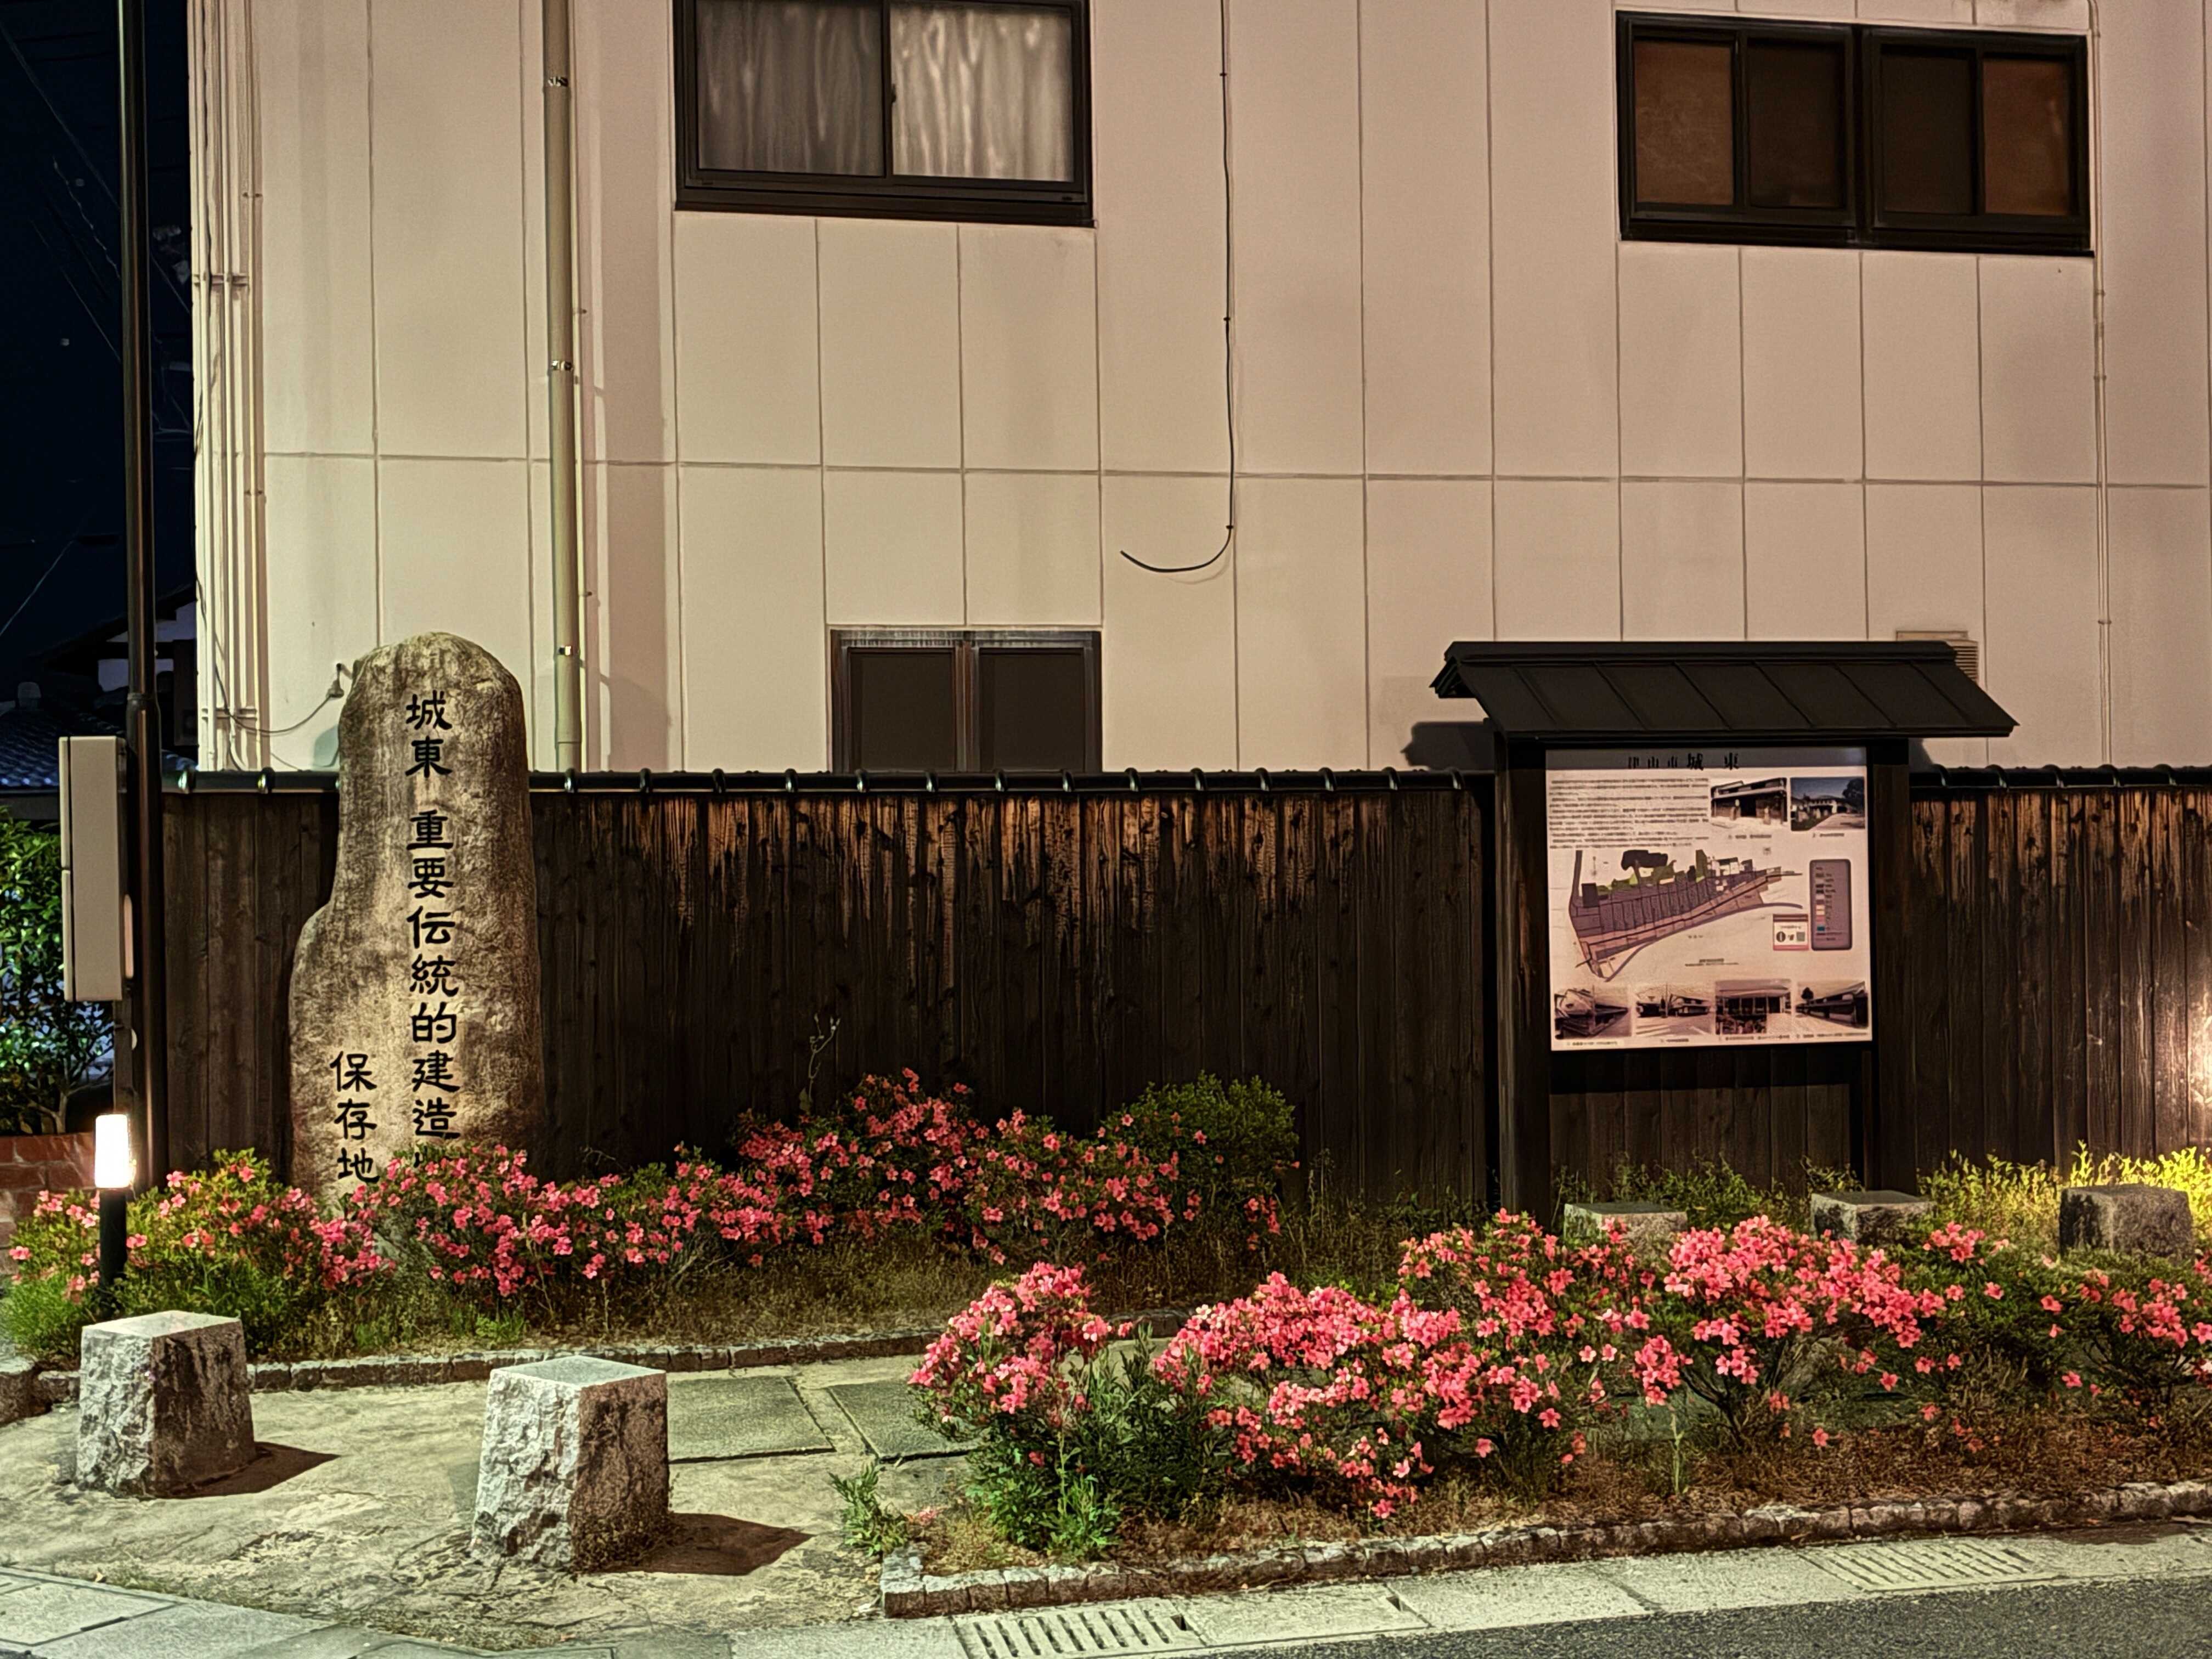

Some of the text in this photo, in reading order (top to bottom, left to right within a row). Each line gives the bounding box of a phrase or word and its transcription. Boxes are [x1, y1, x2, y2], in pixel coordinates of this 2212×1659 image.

[405, 690, 461, 1169] 城東 重要伝統的建造
[329, 1050, 380, 1183] 保存地
